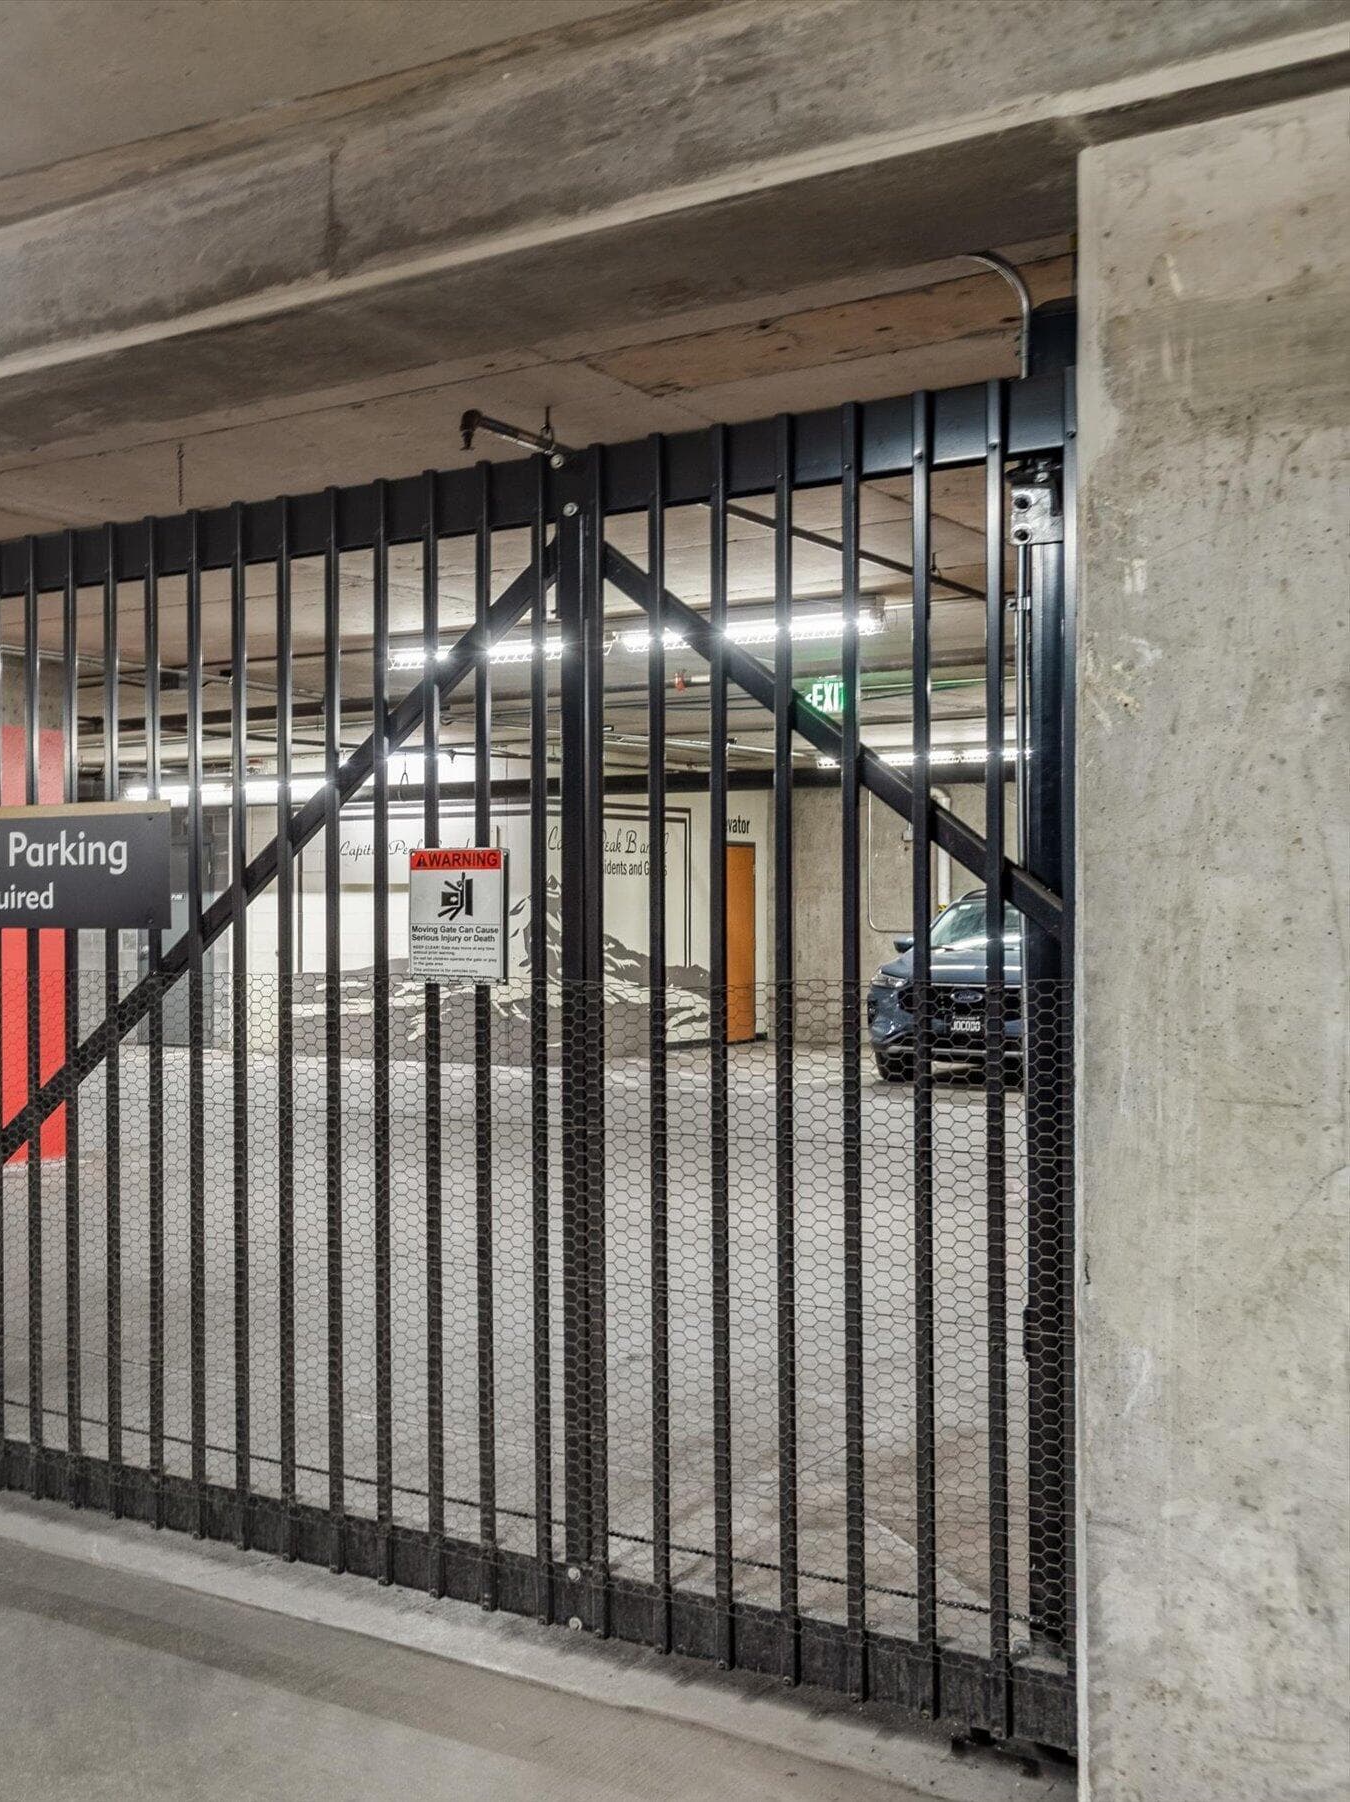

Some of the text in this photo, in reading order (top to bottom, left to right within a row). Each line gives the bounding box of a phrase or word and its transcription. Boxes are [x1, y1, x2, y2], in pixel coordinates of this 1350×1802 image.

[727, 815, 750, 834] vator
[9, 830, 128, 875] Parking
[429, 852, 498, 867] WARNING
[629, 860, 642, 876] and
[412, 926, 438, 934] Moving
[440, 926, 457, 934] Gate
[475, 926, 499, 934] Cause
[441, 934, 461, 943] Injury
[474, 934, 495, 942] Death
